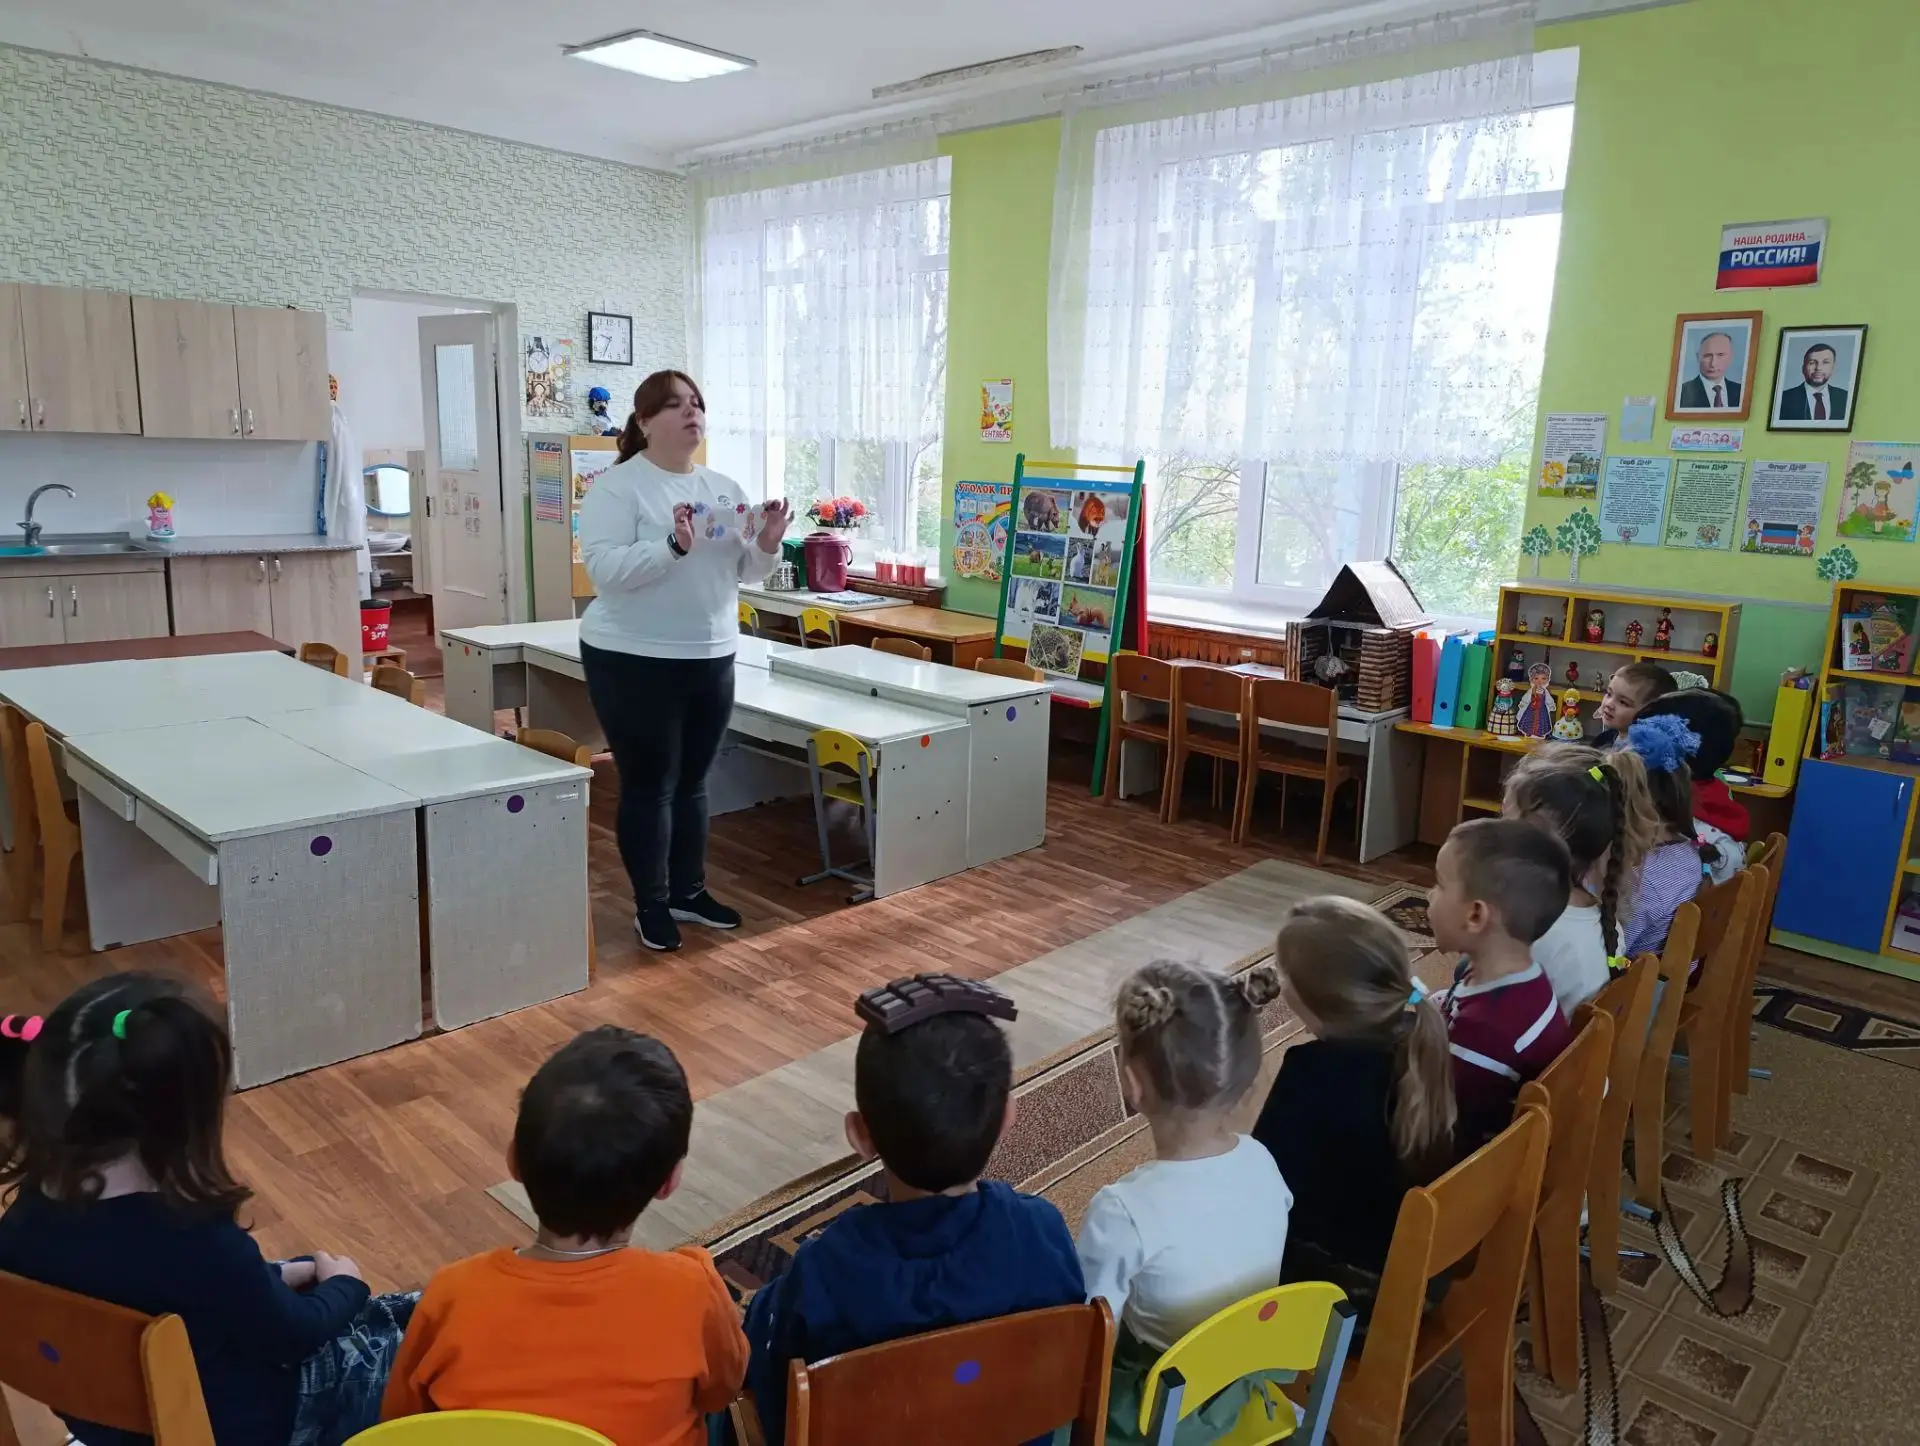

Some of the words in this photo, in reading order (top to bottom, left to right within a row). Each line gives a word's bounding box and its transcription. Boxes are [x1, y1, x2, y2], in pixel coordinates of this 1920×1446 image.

[1734, 235, 1762, 246] НАША
[1765, 232, 1805, 244] РОДИНА
[1731, 247, 1807, 267] РОССИЯ!
[981, 430, 1011, 439] СЕНТЯБРЬ
[958, 483, 996, 495] УГОЛОК
